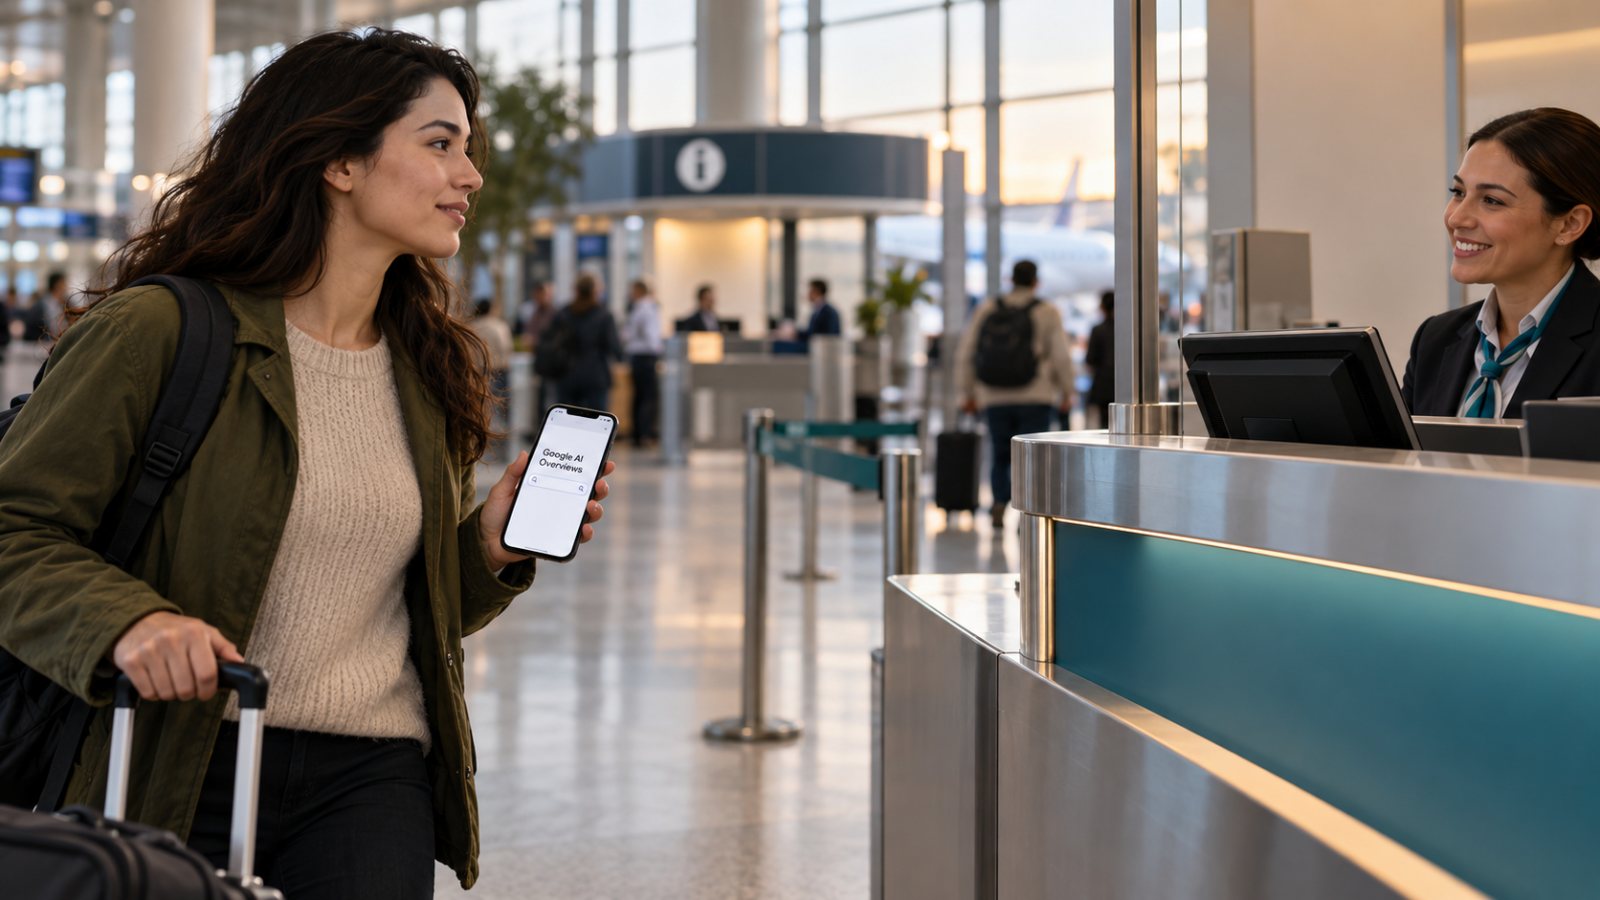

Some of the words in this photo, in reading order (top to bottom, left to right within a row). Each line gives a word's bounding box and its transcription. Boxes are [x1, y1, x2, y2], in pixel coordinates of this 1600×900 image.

[543, 448, 573, 461] Google
[574, 454, 584, 462] AI
[539, 458, 583, 473] Overviews
